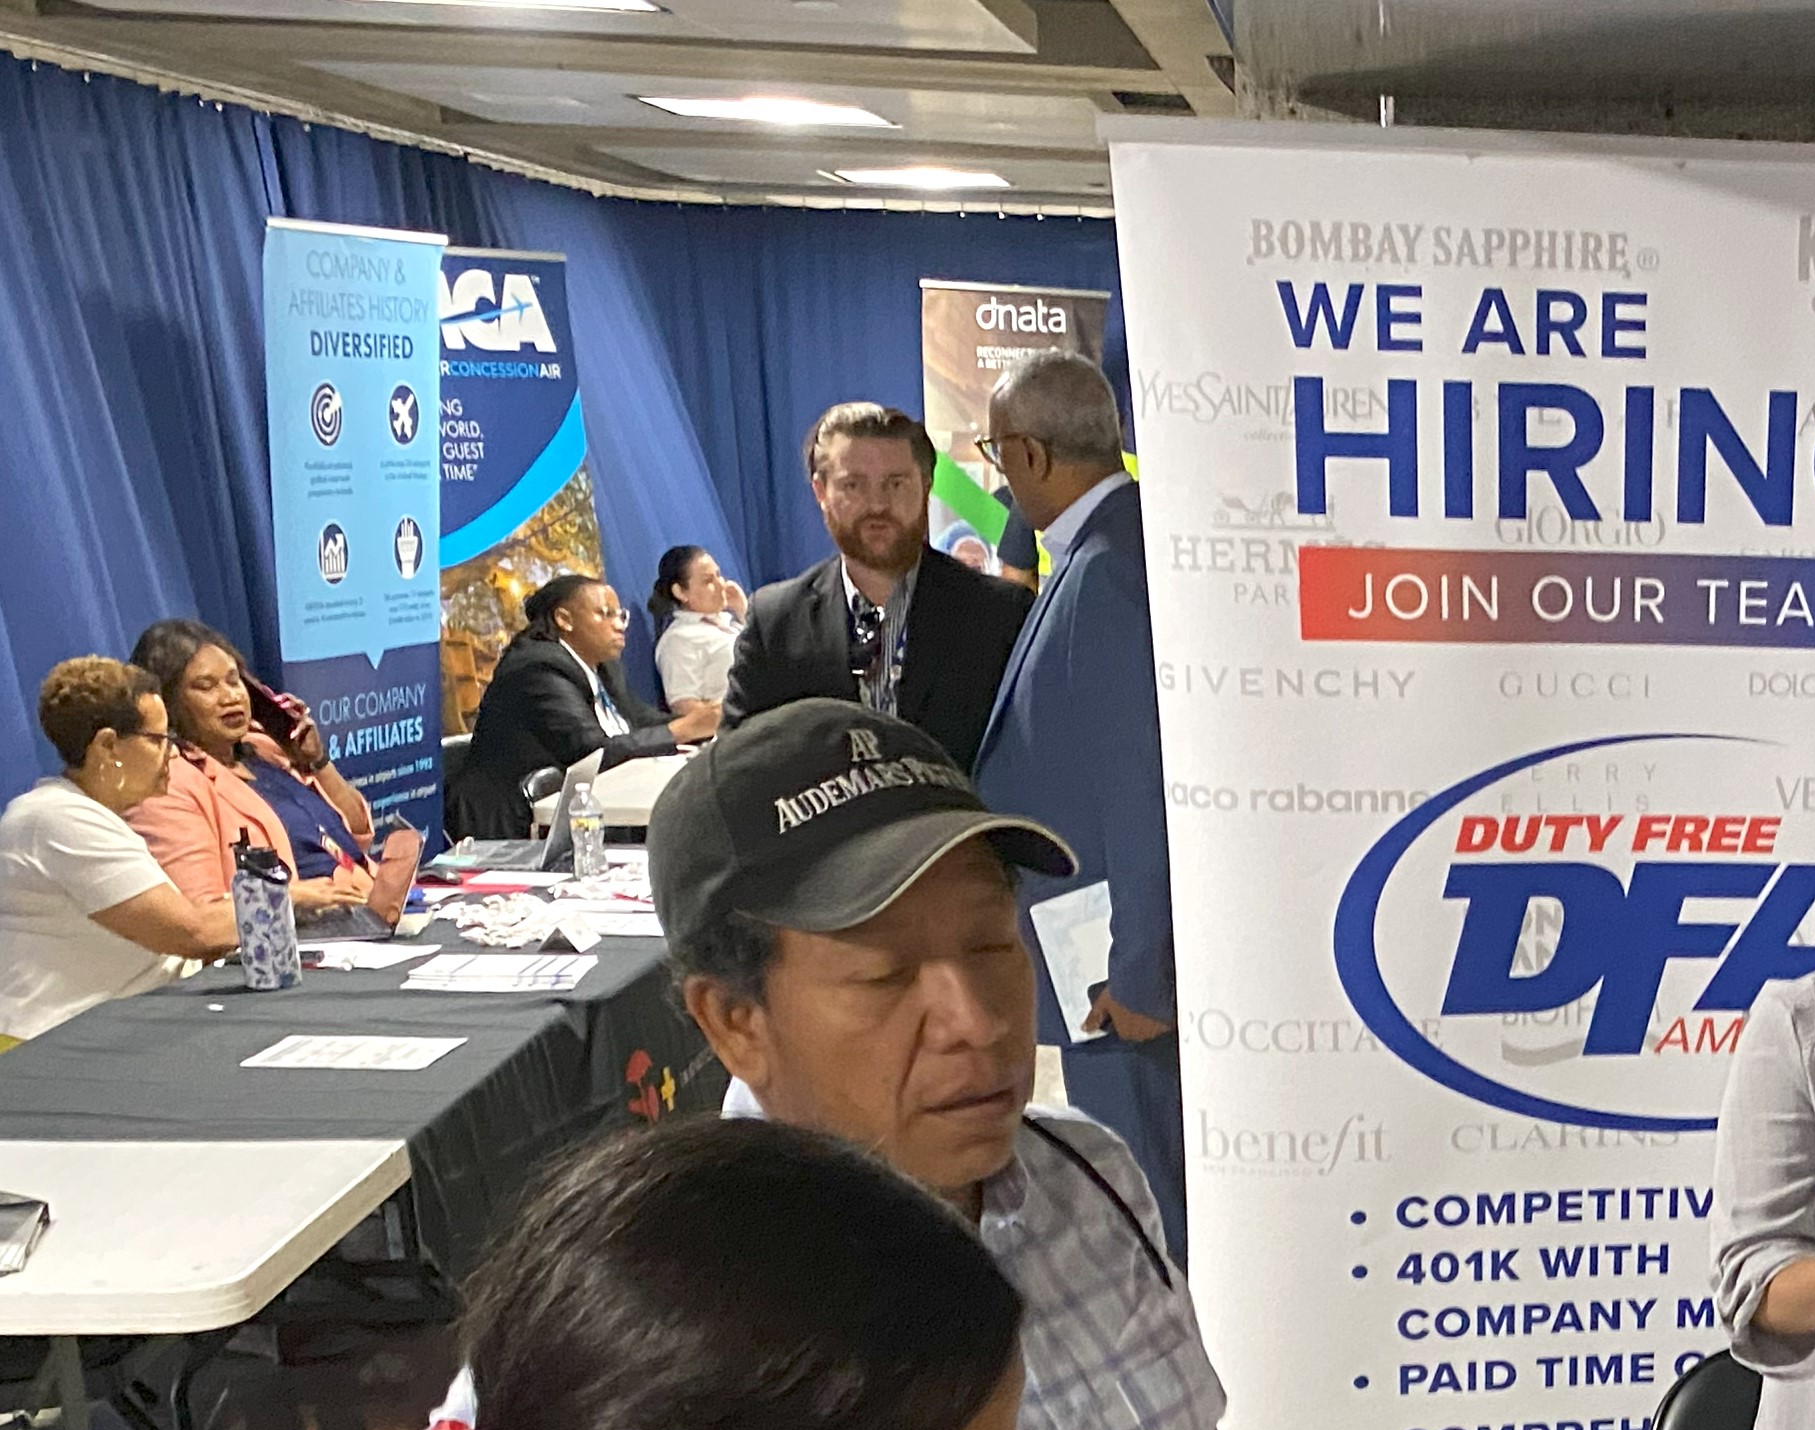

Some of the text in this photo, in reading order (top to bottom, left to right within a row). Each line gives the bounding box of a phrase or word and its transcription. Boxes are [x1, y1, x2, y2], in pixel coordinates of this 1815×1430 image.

[1246, 217, 1423, 266] BOMBAY
[305, 249, 392, 283] COMPANY
[288, 289, 430, 324] AFFILIATES HISTORY
[975, 296, 1067, 334] dnata
[1275, 278, 1649, 360] WE ARE
[310, 328, 414, 359] DIVERSIFIED
[442, 441, 485, 461] GUEST
[1347, 571, 1499, 622] JOIN
[1531, 575, 1666, 624] OUR
[1158, 660, 1416, 699] GIVENCHY
[1499, 671, 1651, 699] GUCCI
[319, 682, 427, 726] OUR COMPANY
[328, 715, 424, 761] & AFFILIATES
[1530, 761, 1658, 784] ERRY
[1166, 780, 1430, 815] aco rabanne
[1454, 815, 1783, 854] DUTY FREE
[1198, 1108, 1392, 1177] benefit
[1395, 1186, 1714, 1229] COMPETITIV
[1396, 1243, 1670, 1285] 401K WITH
[1397, 1297, 1659, 1340] COMPANY
[1399, 1360, 1517, 1396] PAID
[1536, 1351, 1656, 1390] TIME
